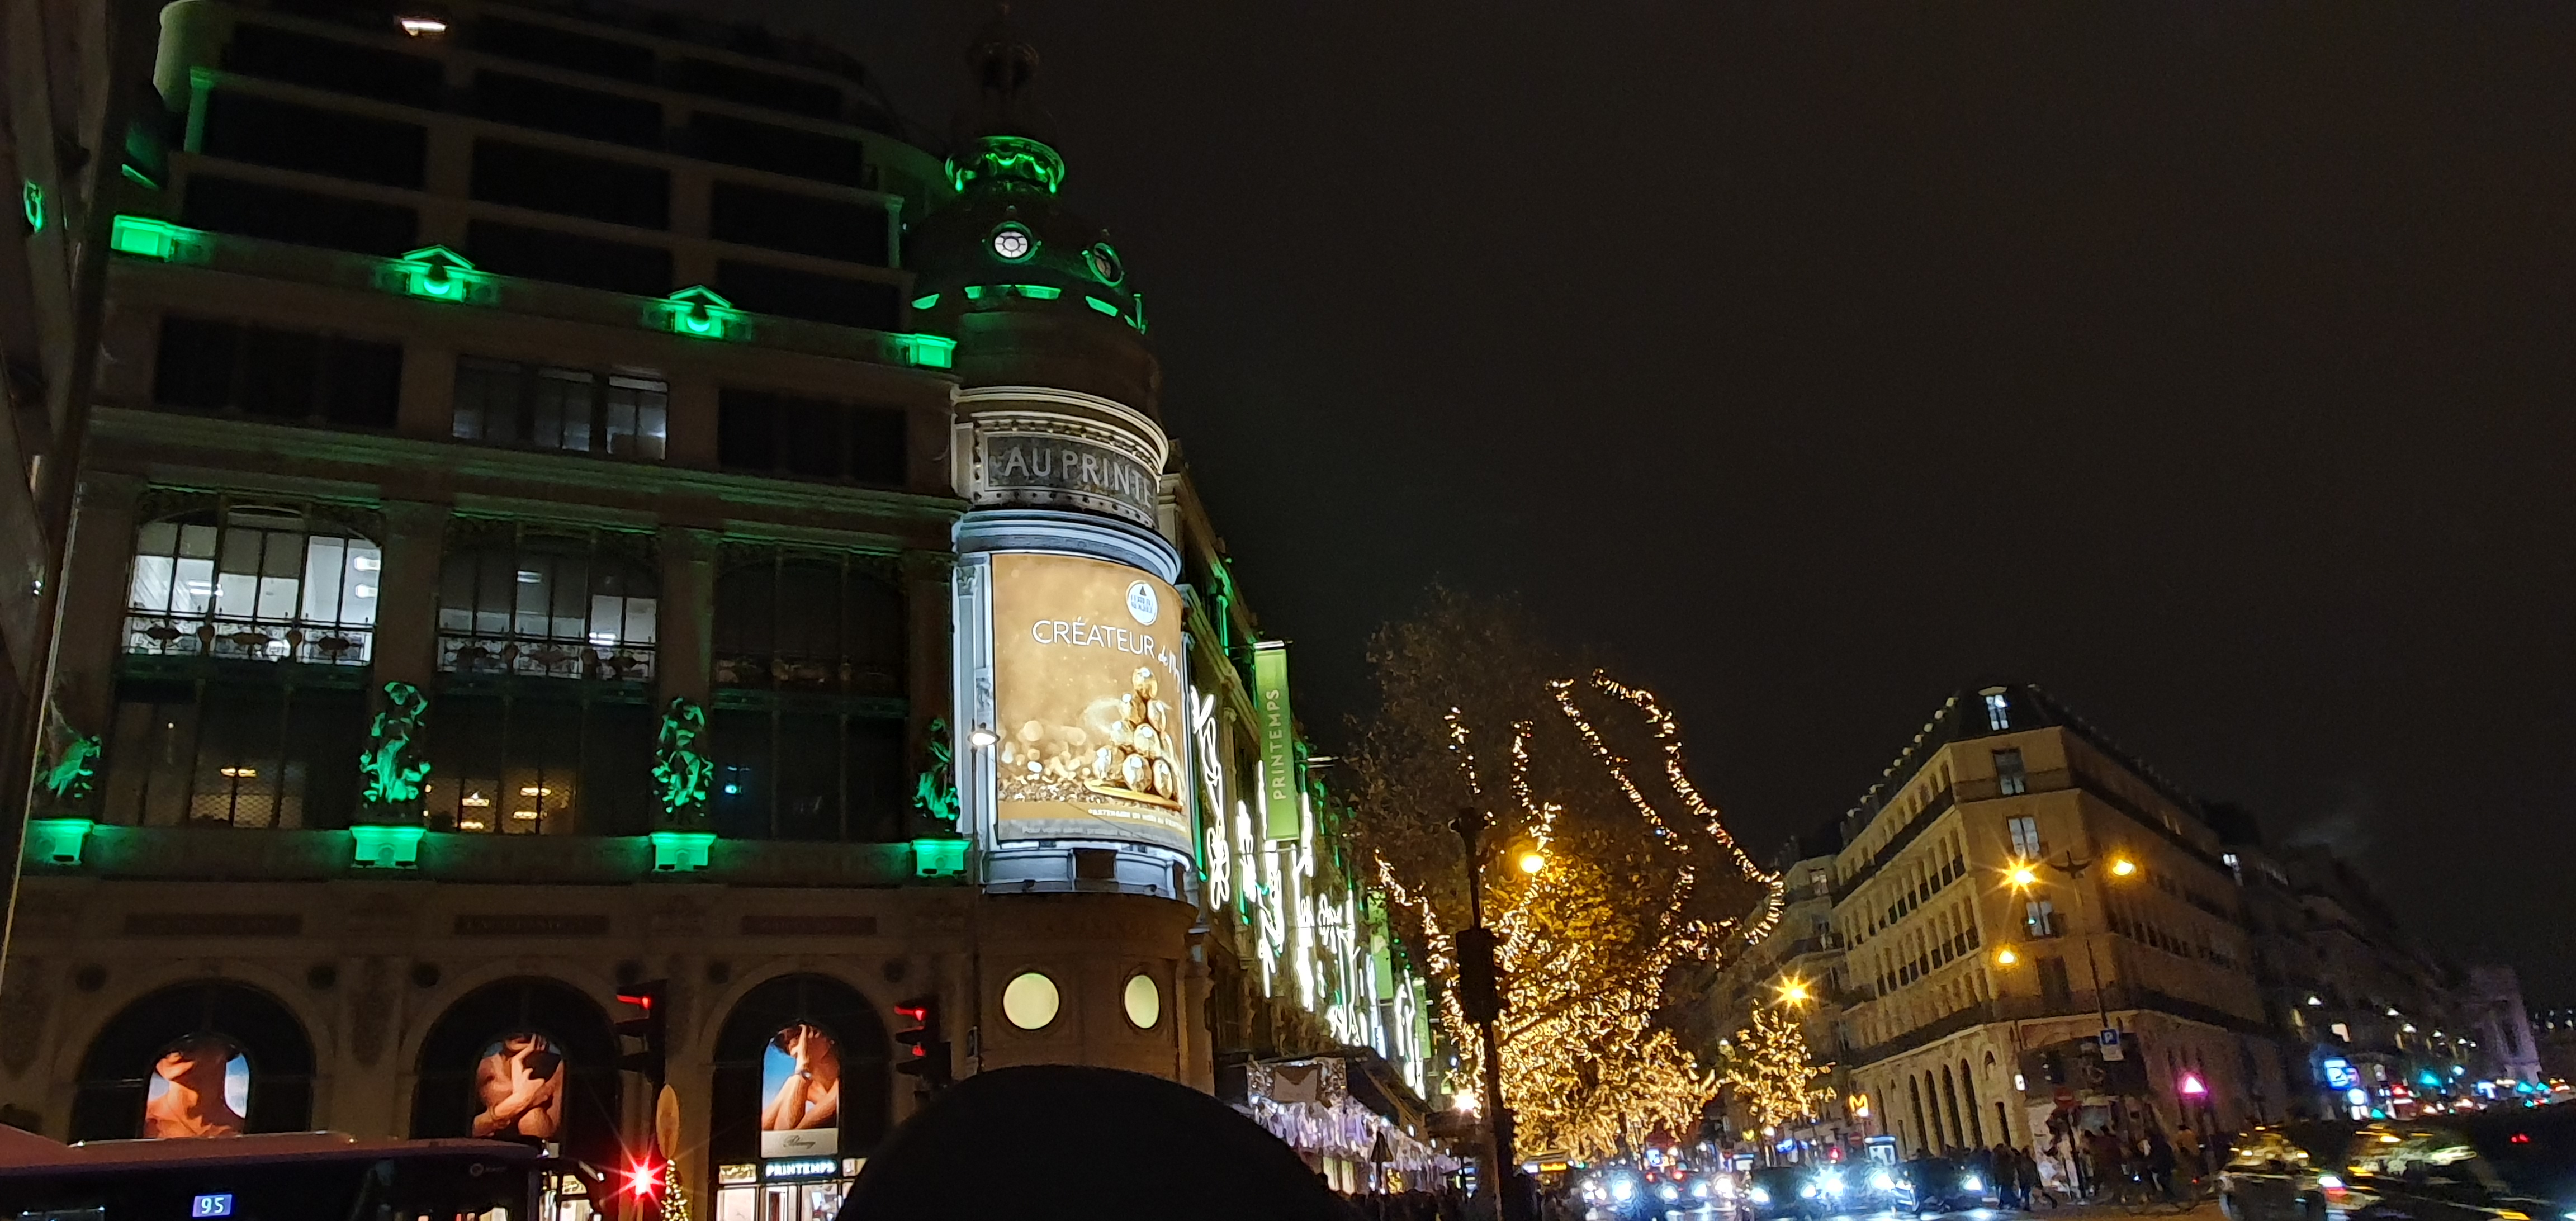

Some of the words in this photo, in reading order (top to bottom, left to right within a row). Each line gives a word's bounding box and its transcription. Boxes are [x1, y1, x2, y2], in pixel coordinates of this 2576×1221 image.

[1005, 447, 1052, 477] AU
[1032, 616, 1155, 659] CRÉATEUR
[1266, 689, 1287, 801] PRINTEMPS
[2104, 1031, 2114, 1044] P
[1848, 1094, 1868, 1113] M
[765, 1161, 836, 1178] PRINTEMPS
[201, 1197, 224, 1214] 95
